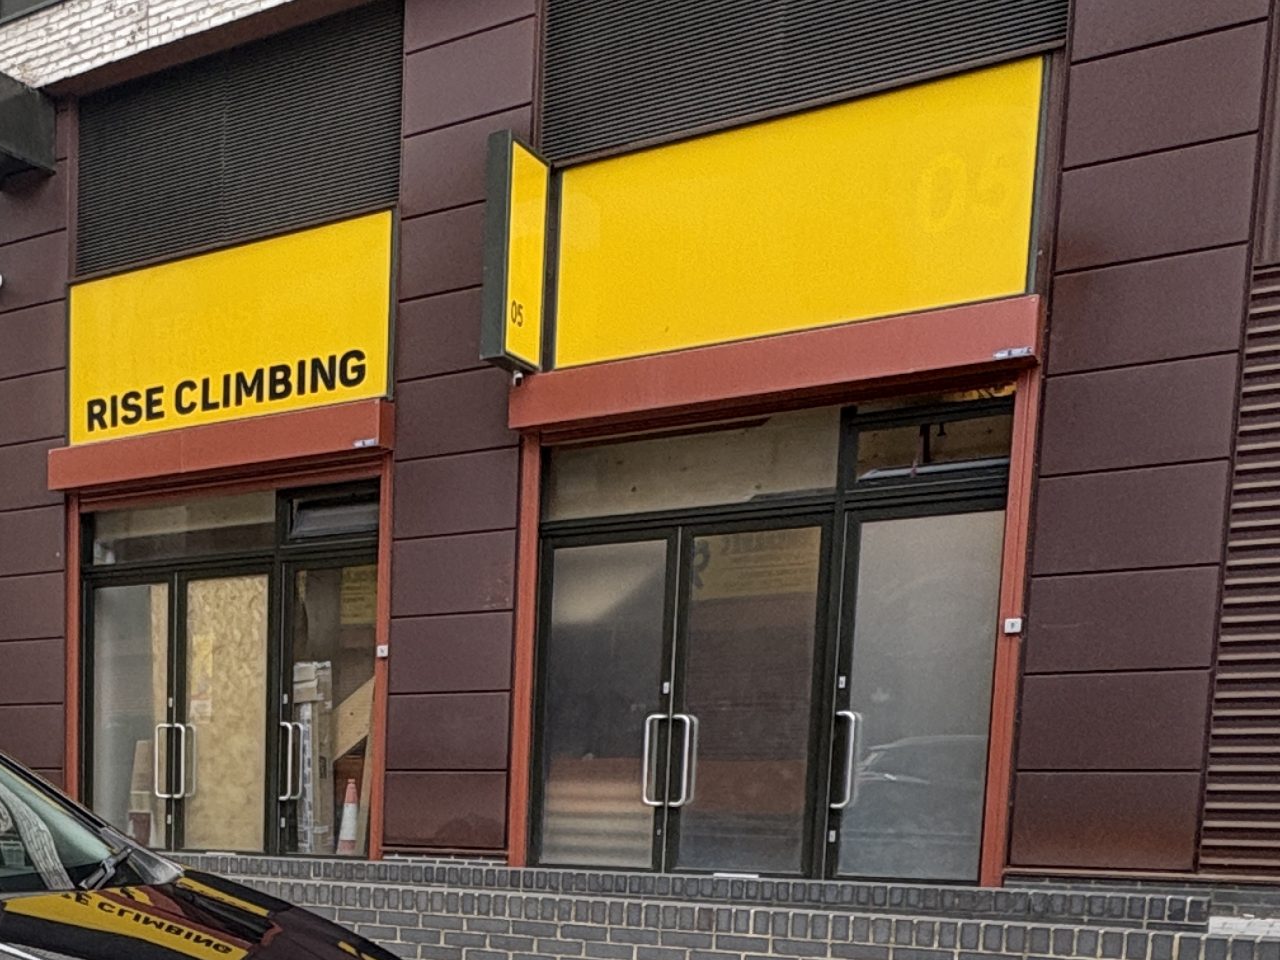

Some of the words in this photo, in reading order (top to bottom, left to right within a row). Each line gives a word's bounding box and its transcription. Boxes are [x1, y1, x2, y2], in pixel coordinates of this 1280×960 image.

[510, 300, 524, 328] 05
[87, 386, 165, 432] RISE
[174, 349, 366, 416] CLIMBING
